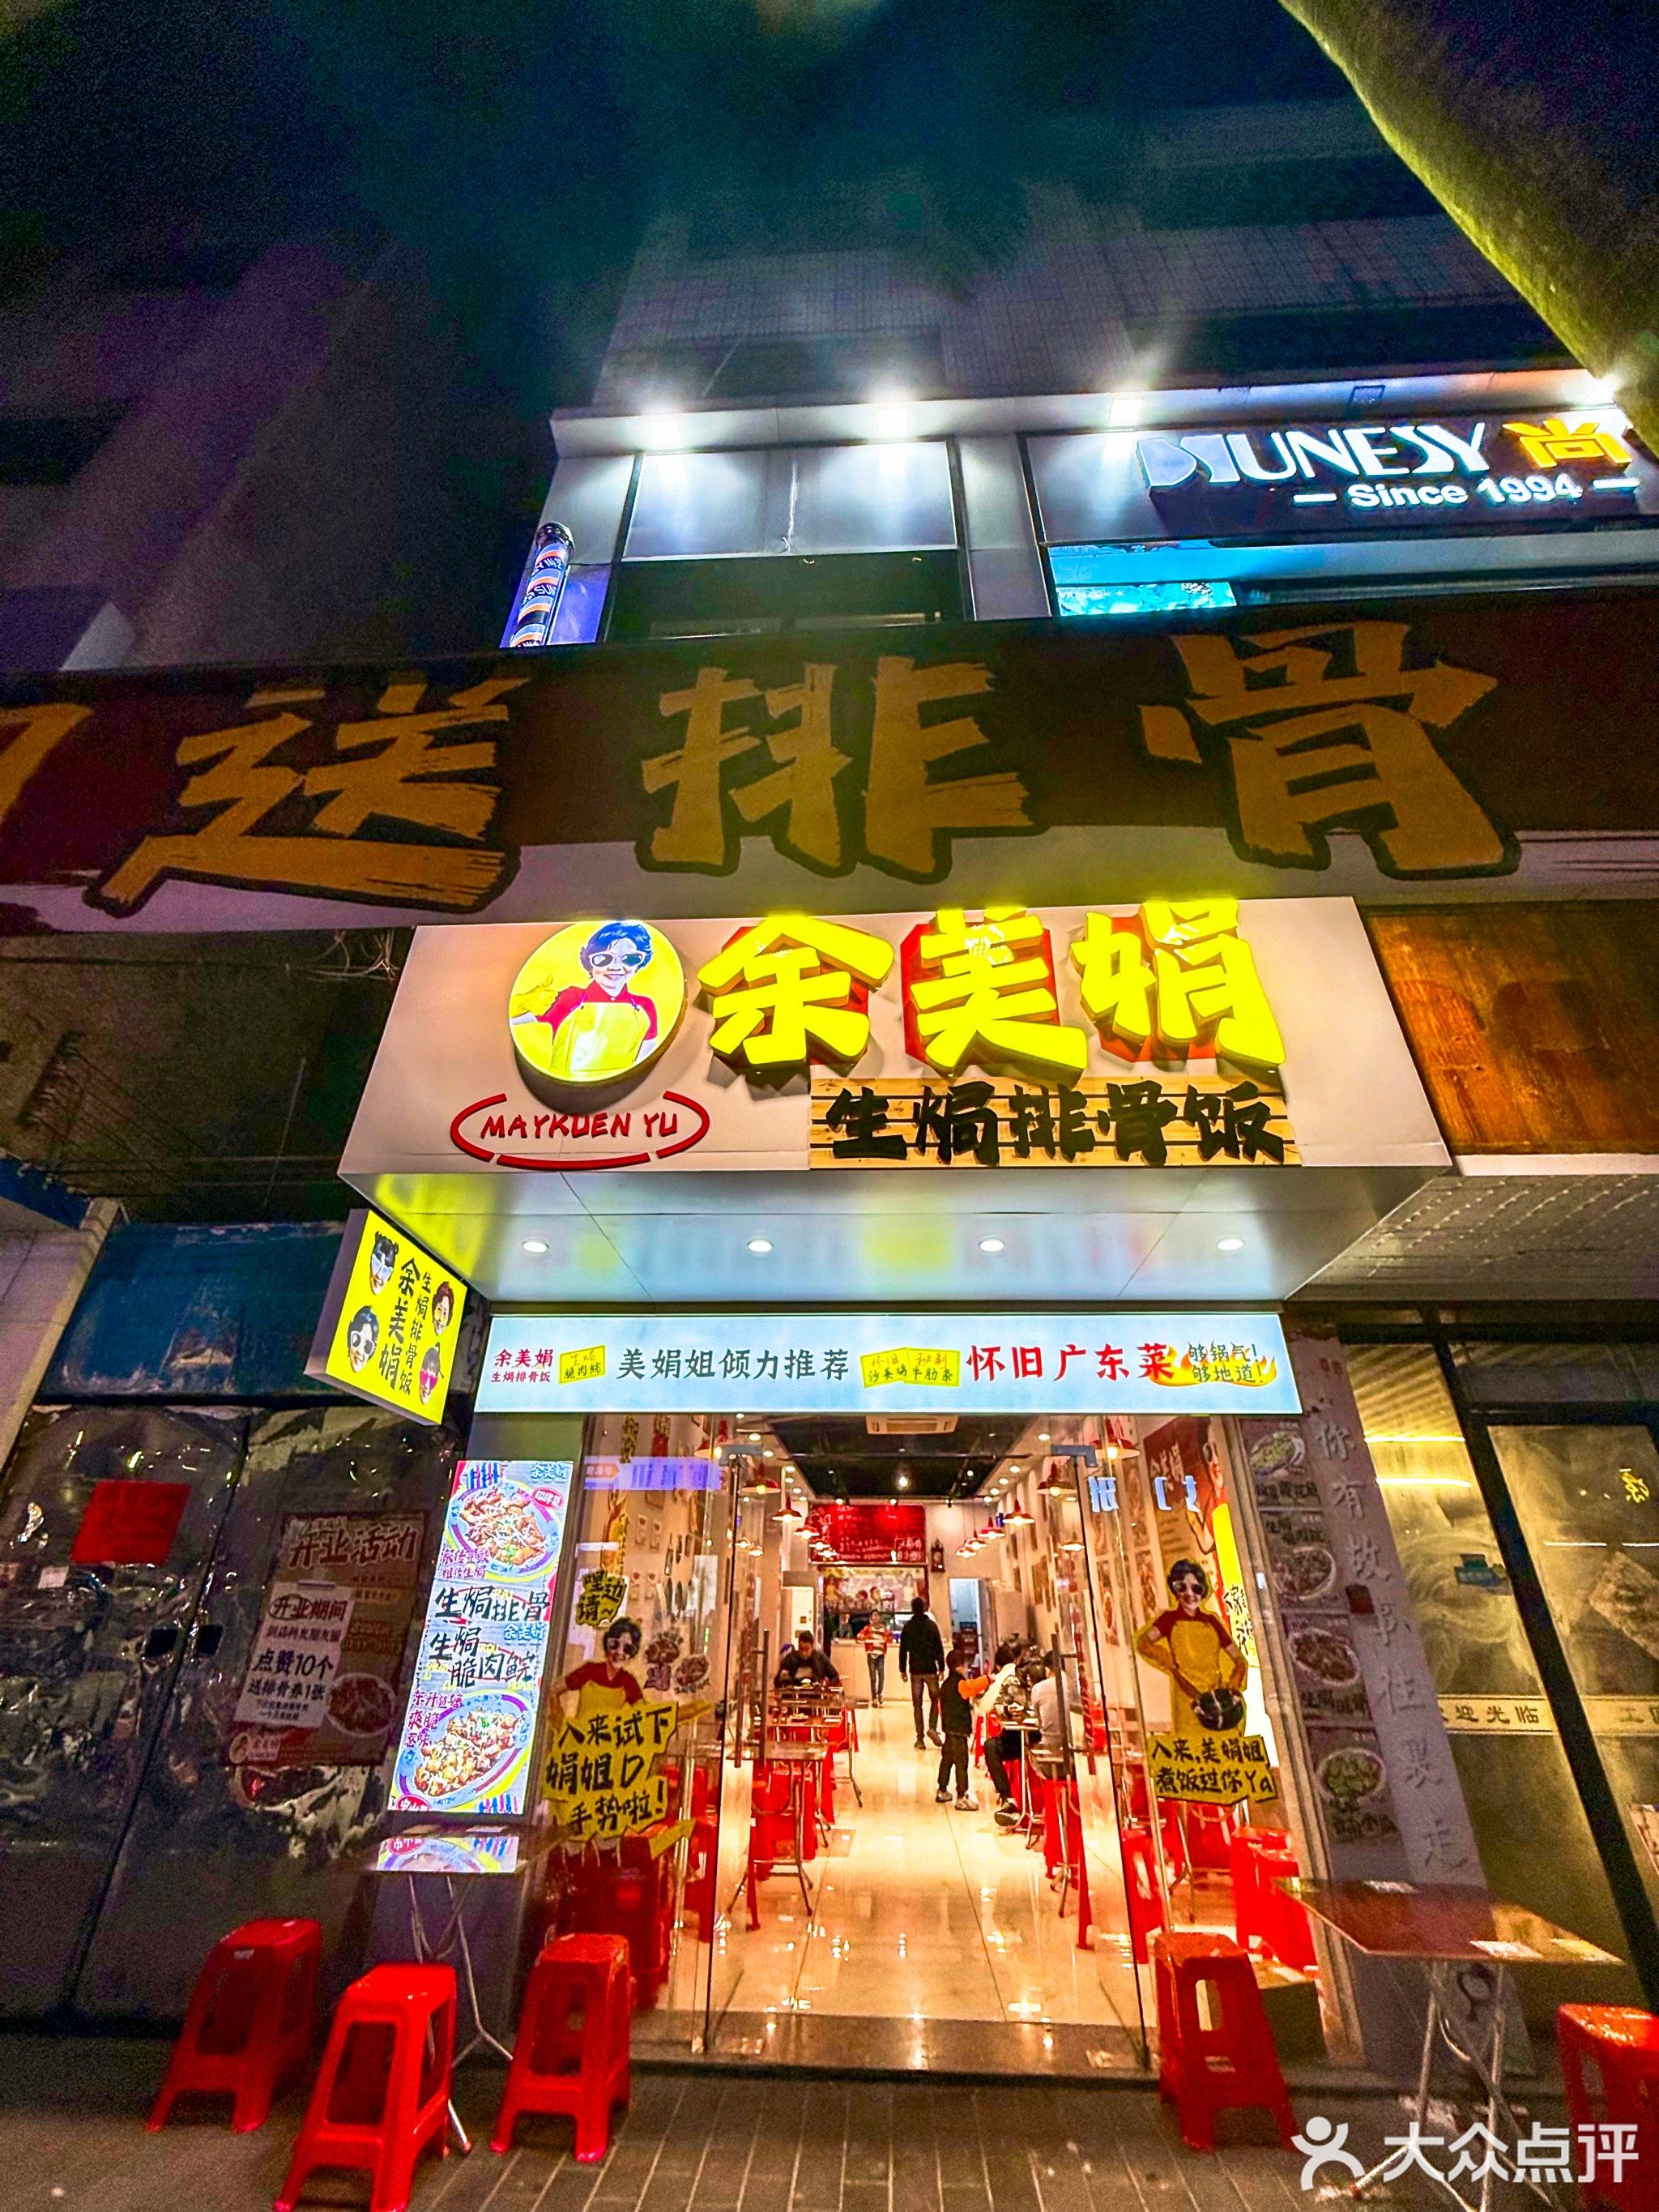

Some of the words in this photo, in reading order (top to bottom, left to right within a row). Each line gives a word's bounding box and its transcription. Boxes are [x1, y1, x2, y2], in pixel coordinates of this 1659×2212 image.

[1348, 483, 1469, 508] Since
[1477, 472, 1583, 504] 1994
[0, 621, 1504, 907] 送排骨
[697, 899, 1286, 1079] 余美娟
[480, 1112, 631, 1139] MAYKUEN
[644, 1113, 678, 1135] YU
[825, 1079, 1285, 1167] 生焗排骨饭
[378, 1258, 421, 1390] 余美娟
[399, 1270, 432, 1395] 生焗排骨饭
[493, 1348, 554, 1368] 余美娟
[616, 1347, 850, 1381] 美娟姐倾力推荐
[966, 1343, 1175, 1382] 怀旧广东菜
[435, 1585, 550, 1621] 生焗排骨
[252, 1648, 334, 1680] 点赞10个
[558, 1706, 672, 1748] 入来试下
